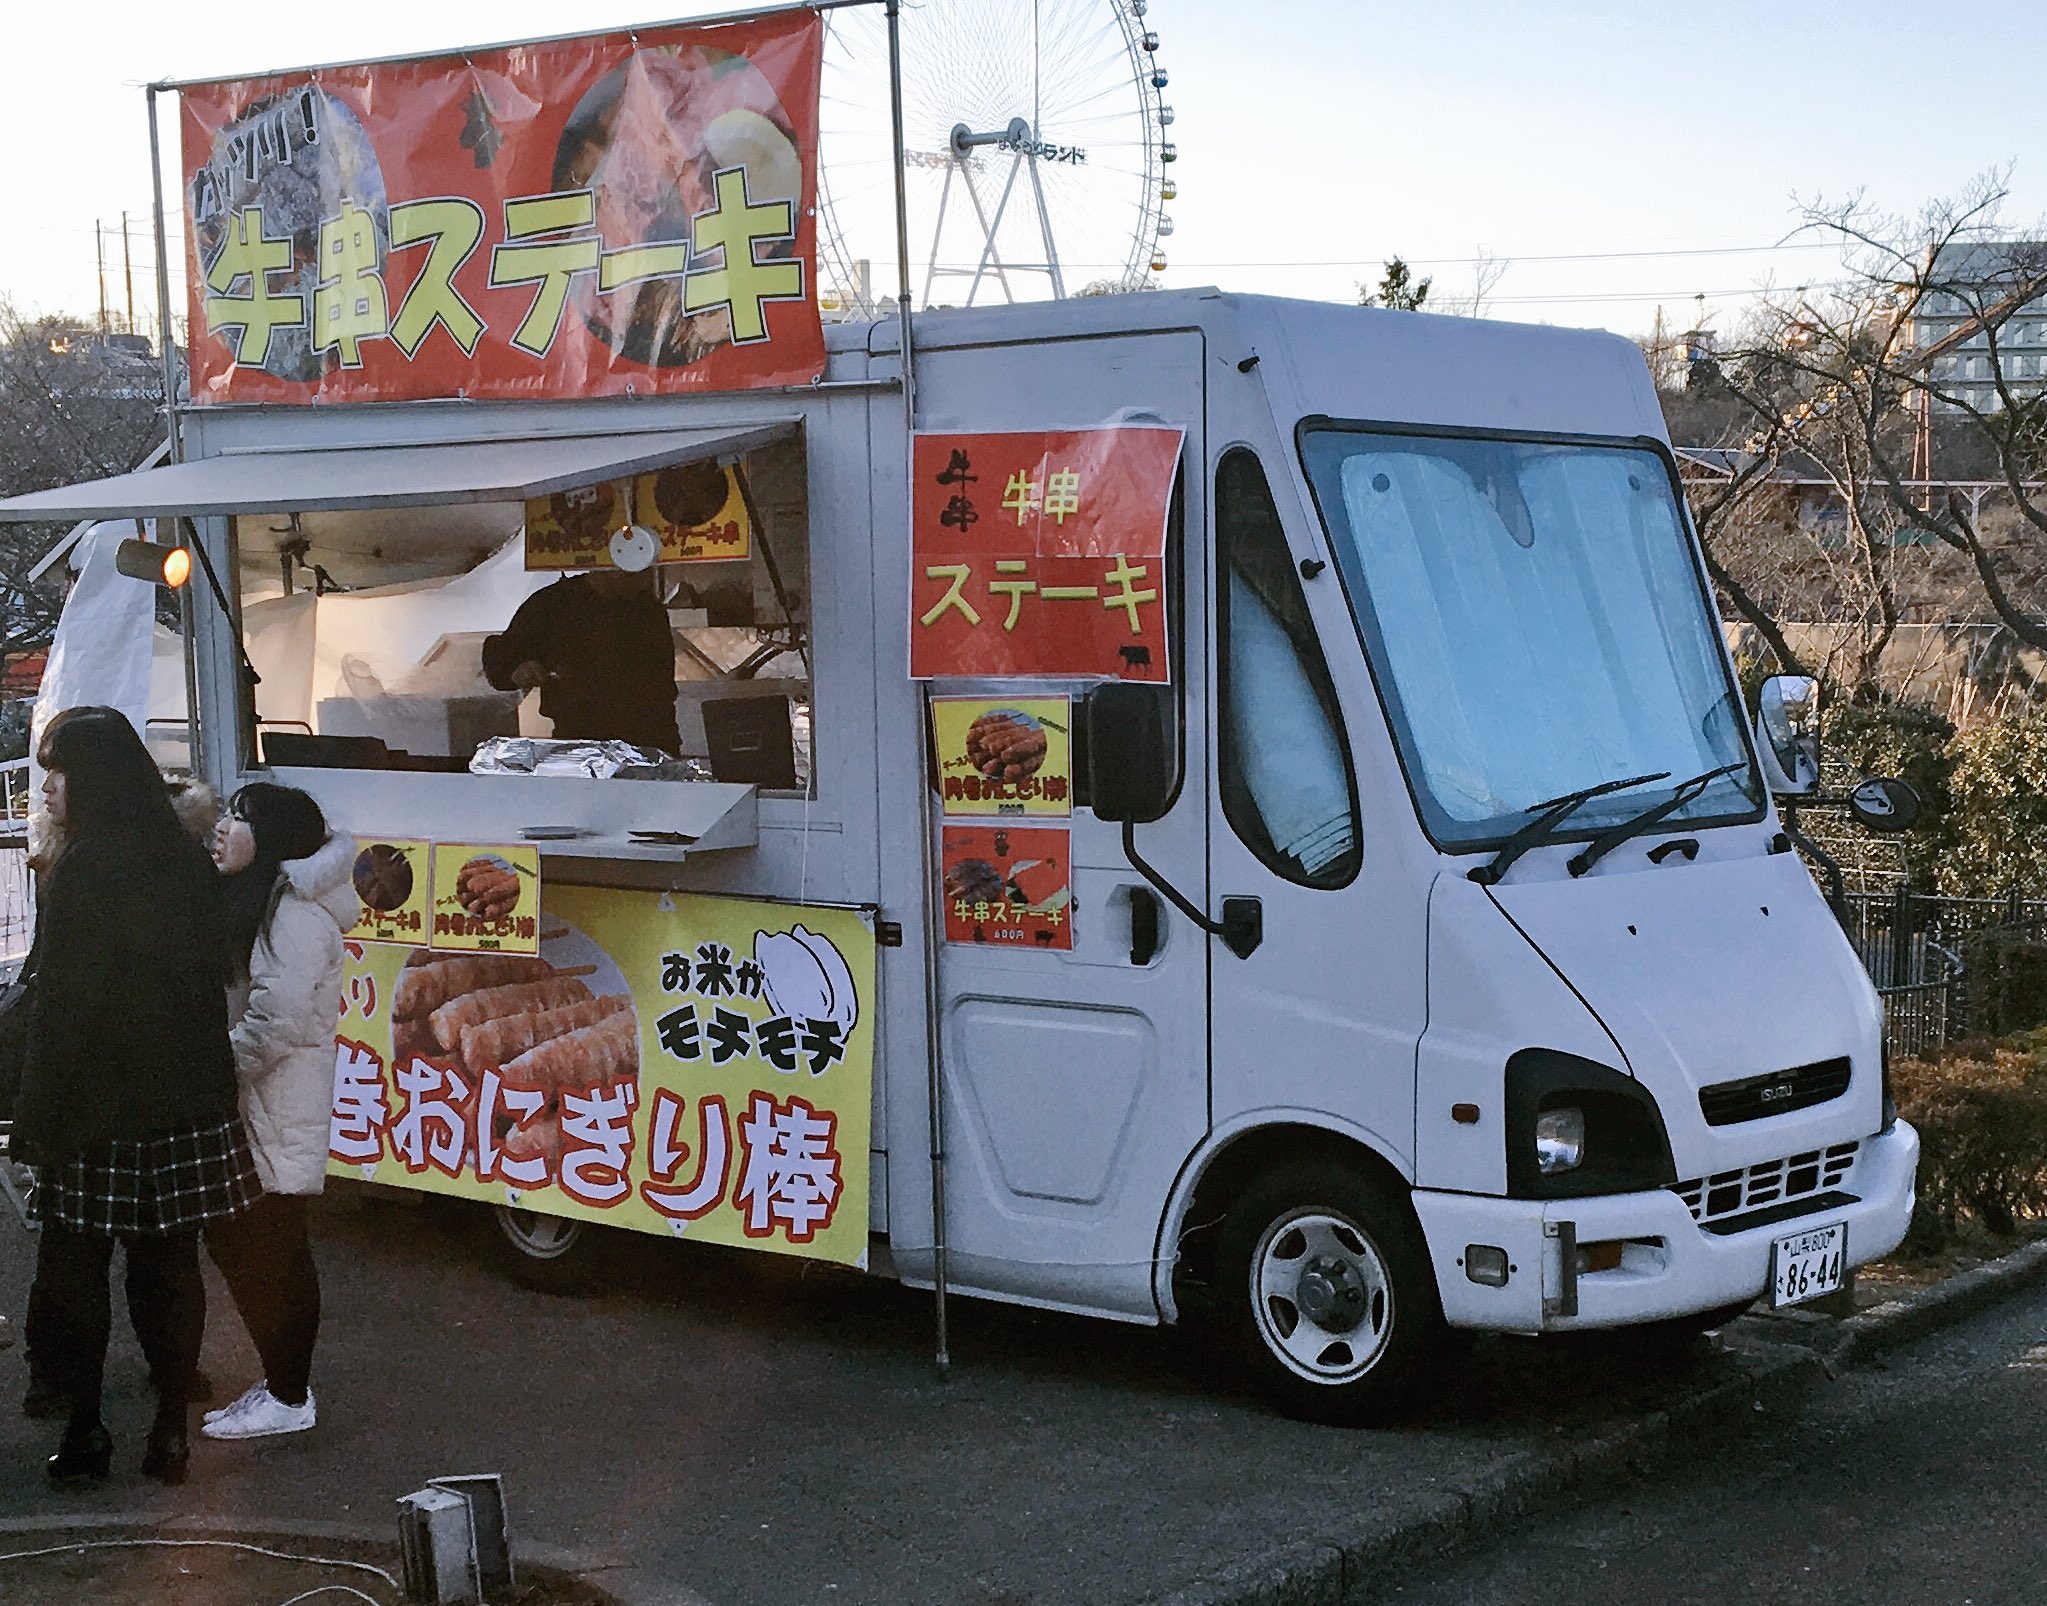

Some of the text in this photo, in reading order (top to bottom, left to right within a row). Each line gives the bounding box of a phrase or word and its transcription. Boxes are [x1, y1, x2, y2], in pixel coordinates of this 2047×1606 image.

[207, 164, 805, 368] 牛串ステーキ
[1001, 466, 1081, 528] 牛串
[919, 553, 1157, 635] ステーキ
[954, 899, 1063, 927] 牛串ステーキ
[660, 942, 766, 1000] お米が
[655, 1003, 845, 1076] モチモチ
[1786, 1251, 1840, 1298] 86-44
